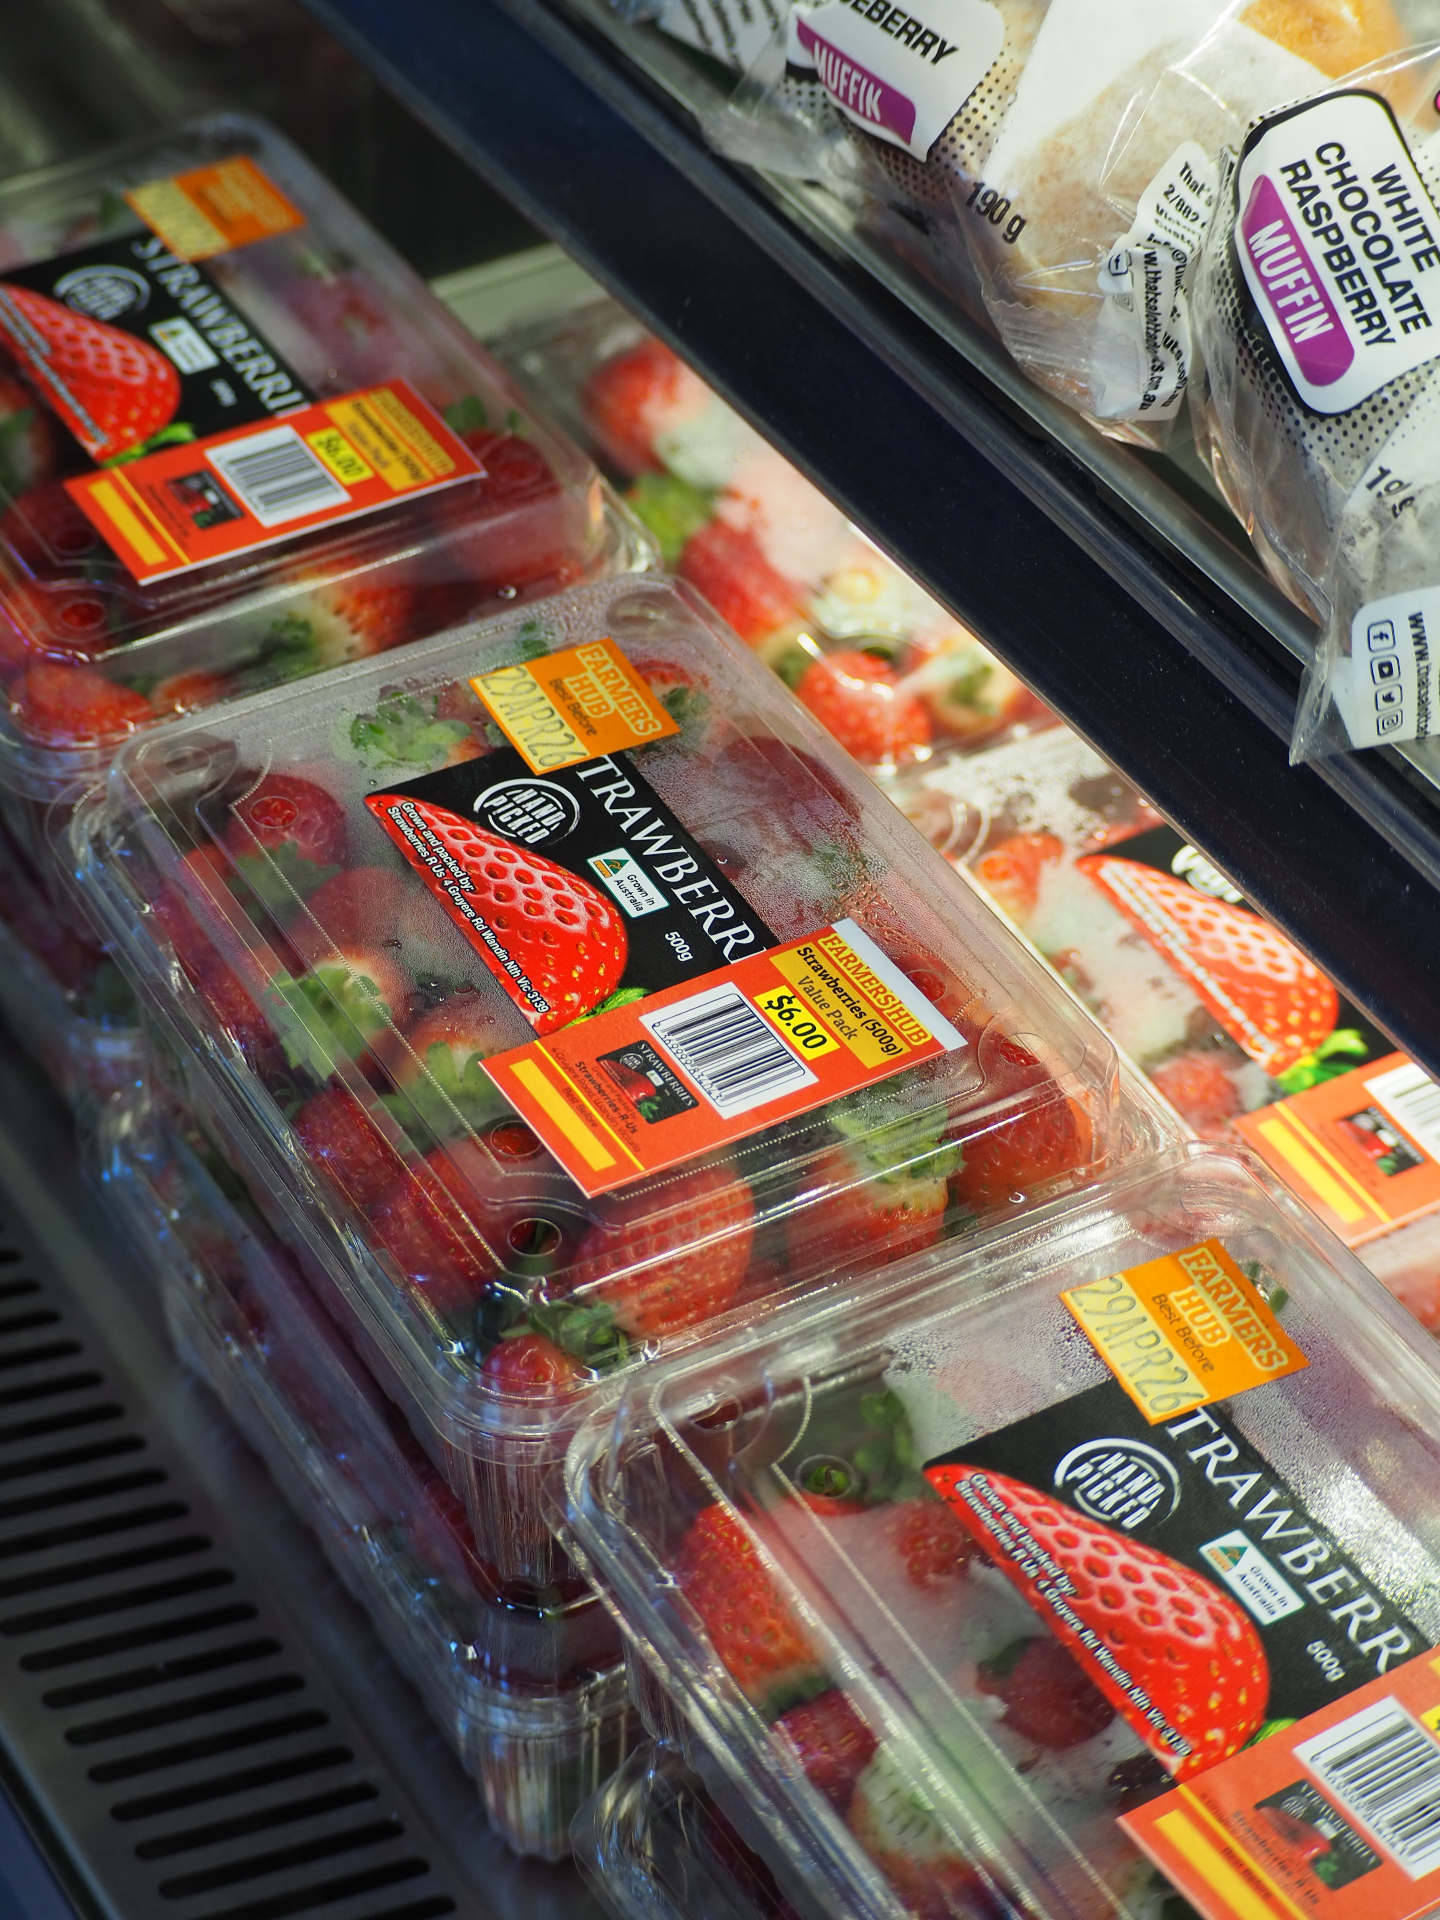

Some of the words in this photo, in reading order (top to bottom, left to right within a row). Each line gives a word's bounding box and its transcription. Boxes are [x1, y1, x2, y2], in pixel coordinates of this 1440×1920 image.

[840, 0, 959, 66] EBERRY
[965, 182, 1012, 226] 190
[1002, 216, 1027, 245] g
[1315, 141, 1432, 334] CHOCOLATE
[1371, 163, 1440, 273] WHITE
[1248, 219, 1334, 344] MUFFIN
[1279, 158, 1397, 347] RASPBERRY
[480, 666, 587, 767] 29APR26
[549, 678, 572, 706] Best
[567, 703, 597, 736] Before
[563, 673, 615, 717] HUB
[578, 645, 662, 735] FARMERS
[401, 801, 426, 832] Grown
[483, 795, 550, 844] PICKED
[512, 788, 567, 826] HAND
[422, 828, 443, 852] and
[432, 846, 464, 879] packed
[576, 754, 767, 964] TRAWBERR
[386, 806, 429, 858] Strawberries
[424, 855, 434, 867] R
[431, 862, 446, 878] Us
[443, 878, 451, 887] 4
[447, 884, 476, 919] Gruyere
[471, 916, 486, 932] Rd
[481, 928, 510, 963] Wandin
[503, 959, 521, 979] Nth
[515, 976, 531, 993] Vic
[527, 989, 550, 1014] 3139
[458, 873, 476, 893] by:
[614, 879, 644, 912] Australia
[626, 873, 649, 901] Grown
[645, 896, 655, 906] in
[665, 930, 693, 962] 500g
[764, 993, 828, 1050] $6.00
[796, 946, 868, 1020] Strawberries
[861, 1016, 904, 1058] (500g)
[796, 975, 831, 1011] Value
[826, 1008, 858, 1042] Pack
[554, 1052, 581, 1079] Gruyere
[638, 1043, 695, 1106] STRAWBERRIES
[562, 1087, 580, 1104] Best
[575, 1104, 600, 1128] Before
[1151, 1293, 1181, 1326] Best
[1175, 1326, 1214, 1372] Before
[1168, 1285, 1231, 1346] HUB
[1178, 1247, 1288, 1371] FARMERS
[1070, 1277, 1204, 1413] 29APR26
[1065, 1461, 1150, 1529] PICKED
[1097, 1452, 1165, 1504] HAND
[1165, 1406, 1411, 1675] TRAWBERR
[1235, 1571, 1277, 1617] Australia
[1249, 1564, 1279, 1601] Grown
[1306, 1639, 1346, 1684] 500g
